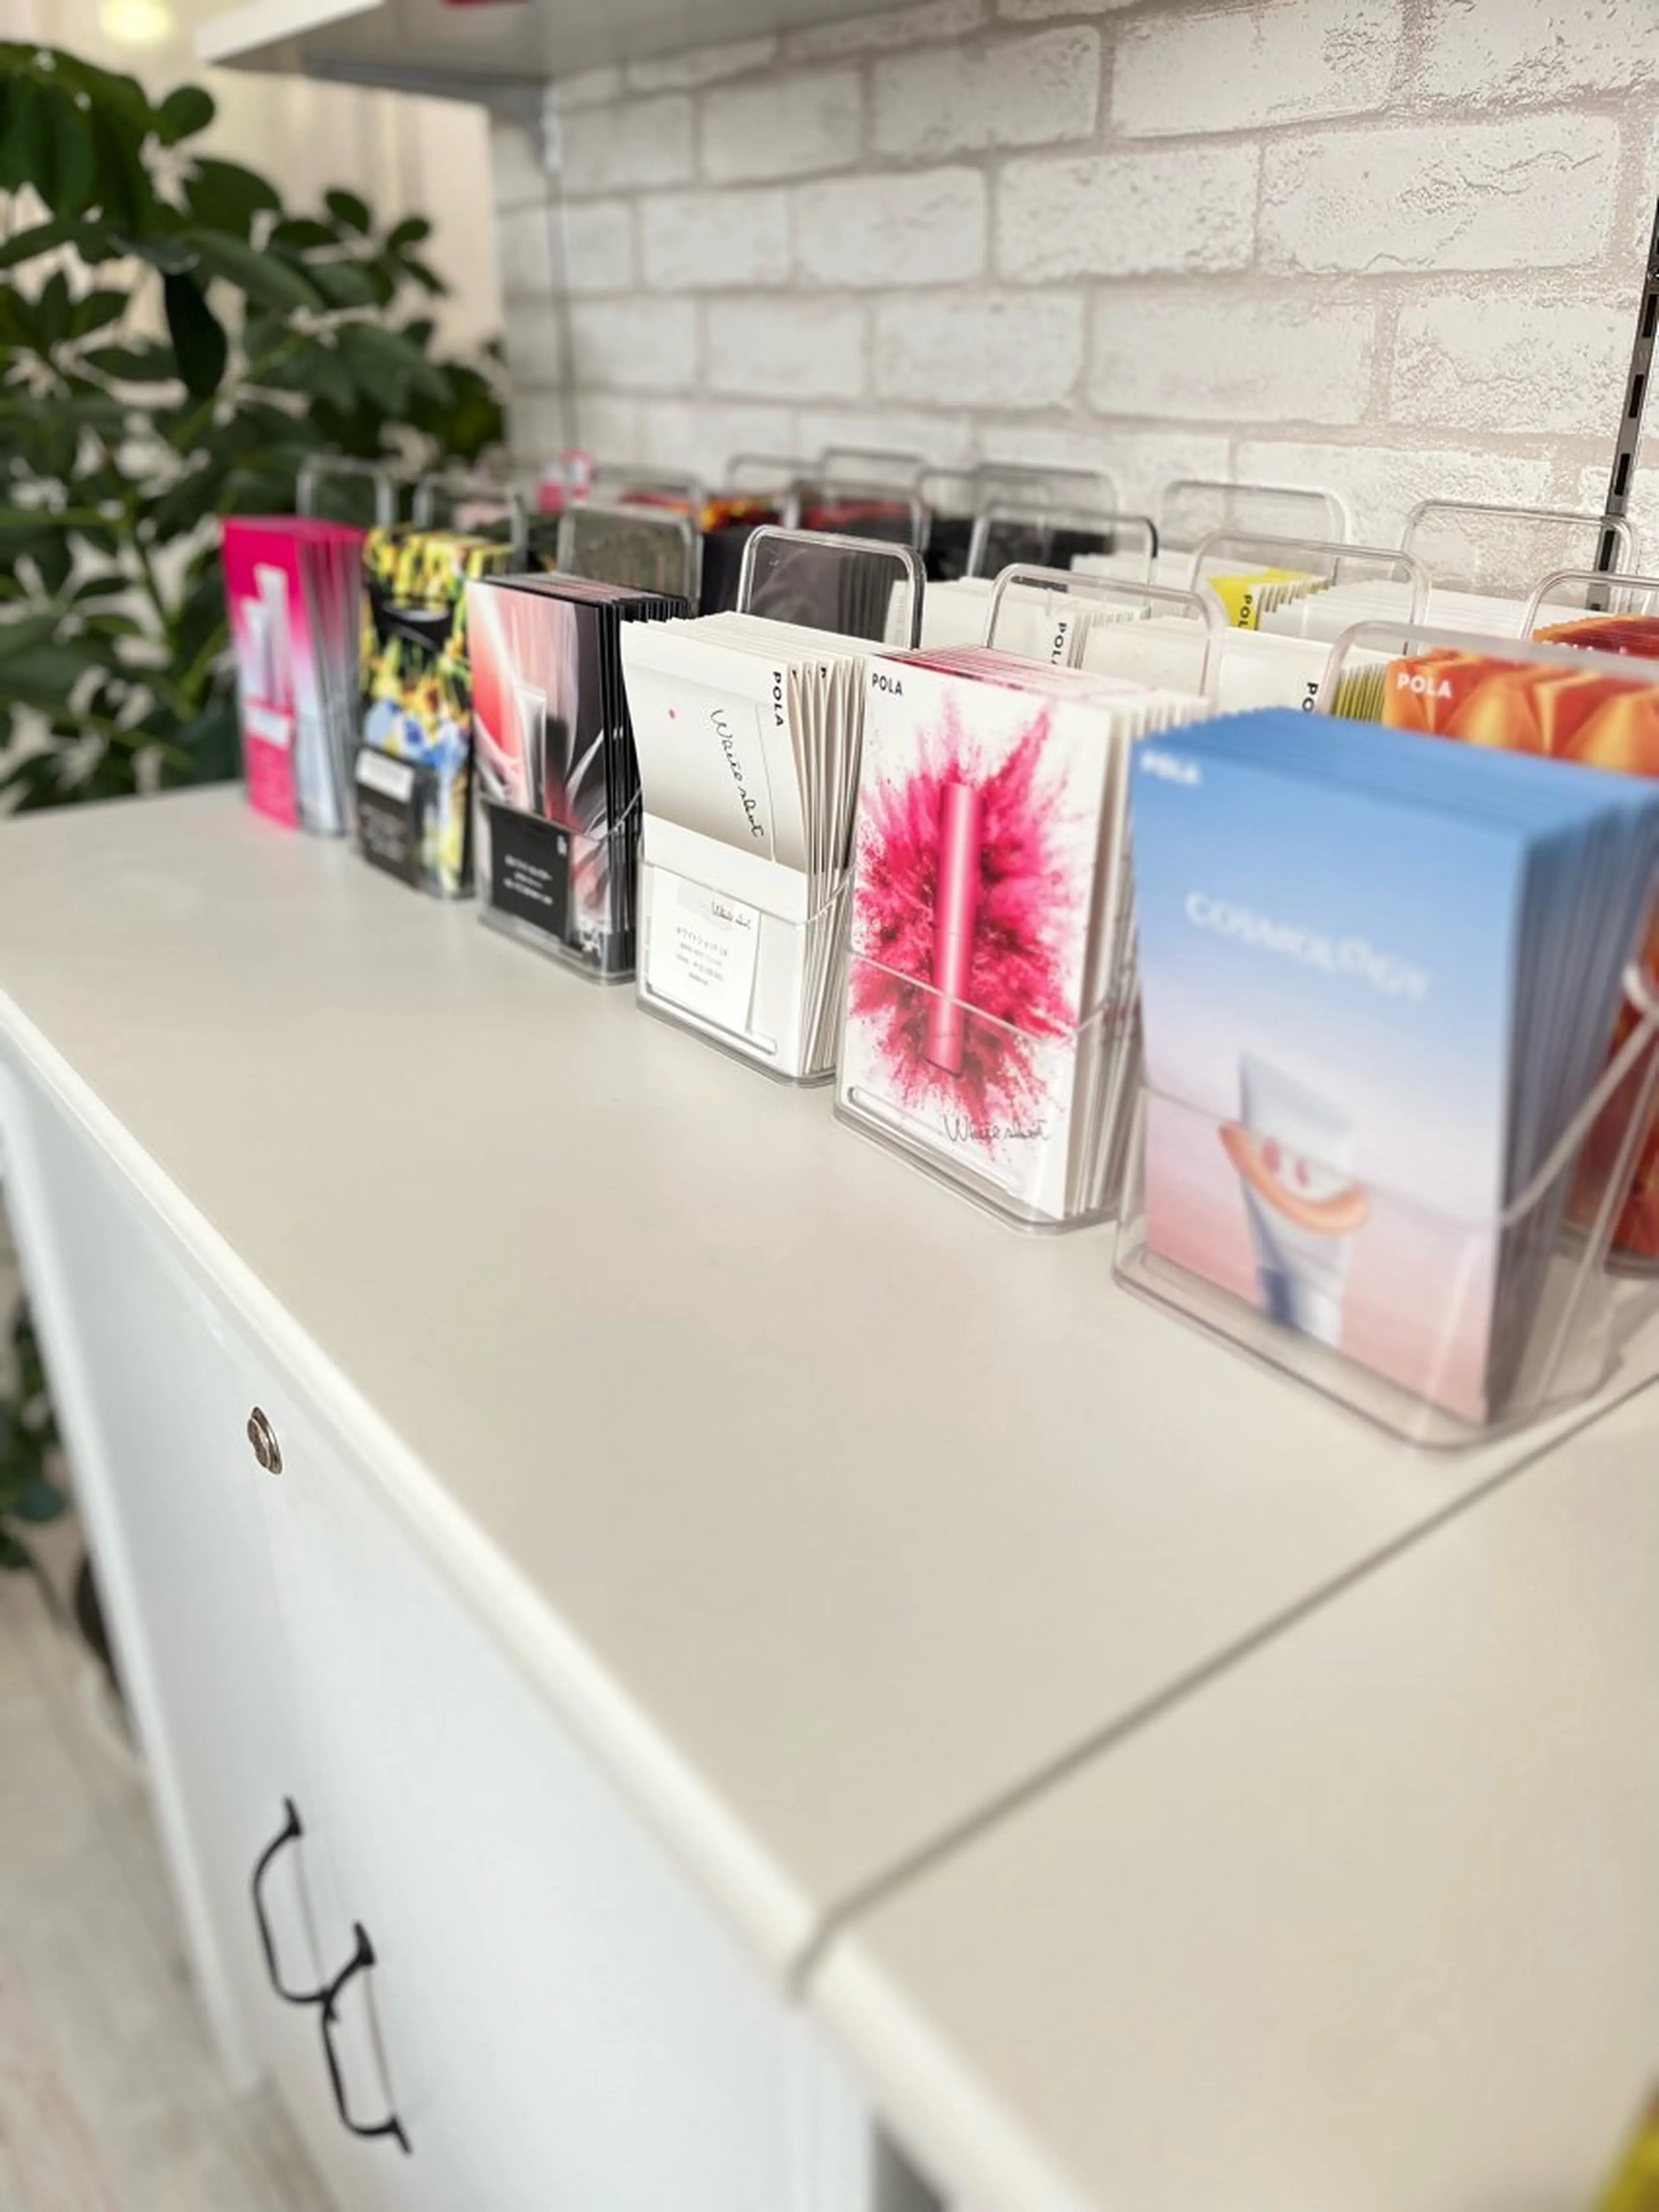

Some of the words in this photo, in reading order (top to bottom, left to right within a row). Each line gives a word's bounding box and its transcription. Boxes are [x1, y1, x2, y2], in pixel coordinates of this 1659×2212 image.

[1238, 594, 1253, 628] POL
[1051, 622, 1068, 665] POL
[772, 671, 784, 727] POLA
[871, 673, 903, 696] POLA
[1302, 682, 1319, 712] PO
[1396, 672, 1452, 699] POLA
